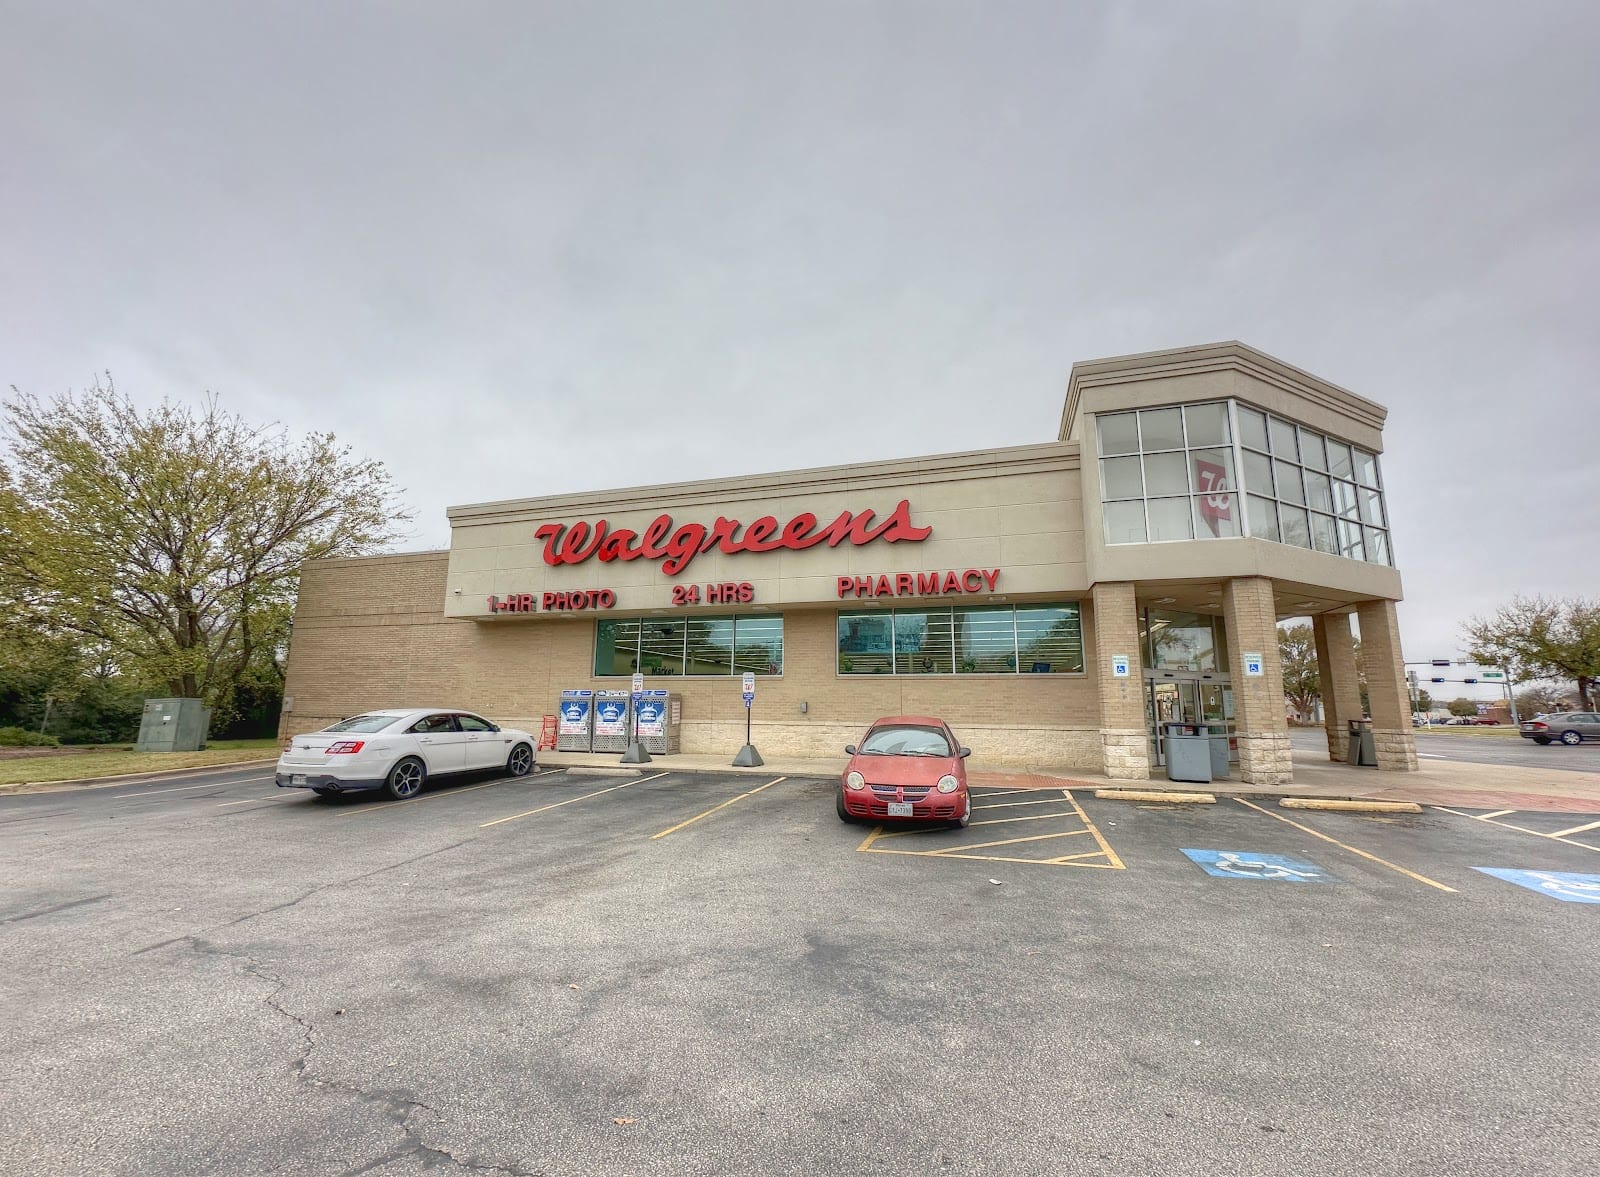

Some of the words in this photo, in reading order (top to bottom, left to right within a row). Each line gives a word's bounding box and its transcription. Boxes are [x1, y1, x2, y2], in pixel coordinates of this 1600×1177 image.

[534, 499, 933, 576] Walgreens
[672, 584, 699, 605] 24
[706, 582, 754, 604] HRS
[837, 568, 1001, 598] PHARMACY
[487, 593, 534, 613] 1-HR
[542, 588, 615, 611] PHOTO
